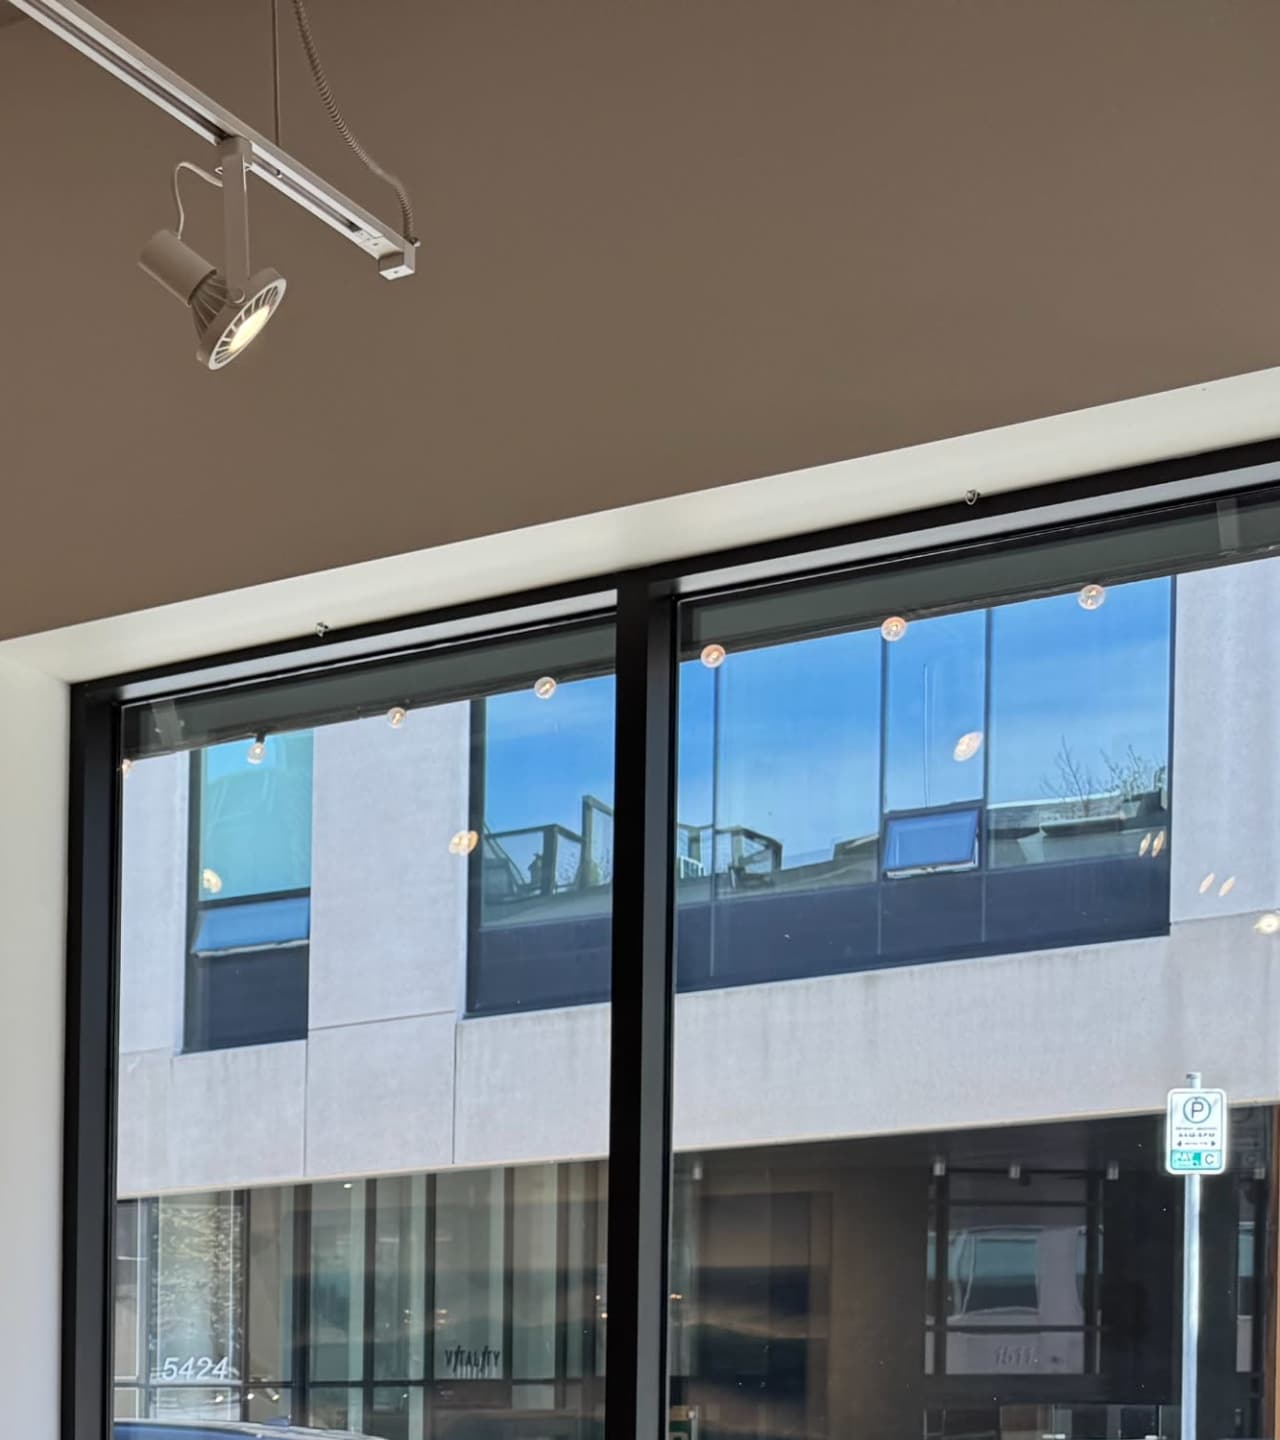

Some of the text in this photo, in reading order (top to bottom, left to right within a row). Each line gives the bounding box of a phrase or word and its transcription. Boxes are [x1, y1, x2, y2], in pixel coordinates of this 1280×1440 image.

[1191, 1101, 1204, 1119] P
[1204, 1153, 1215, 1166] C
[162, 1356, 228, 1380] 5424
